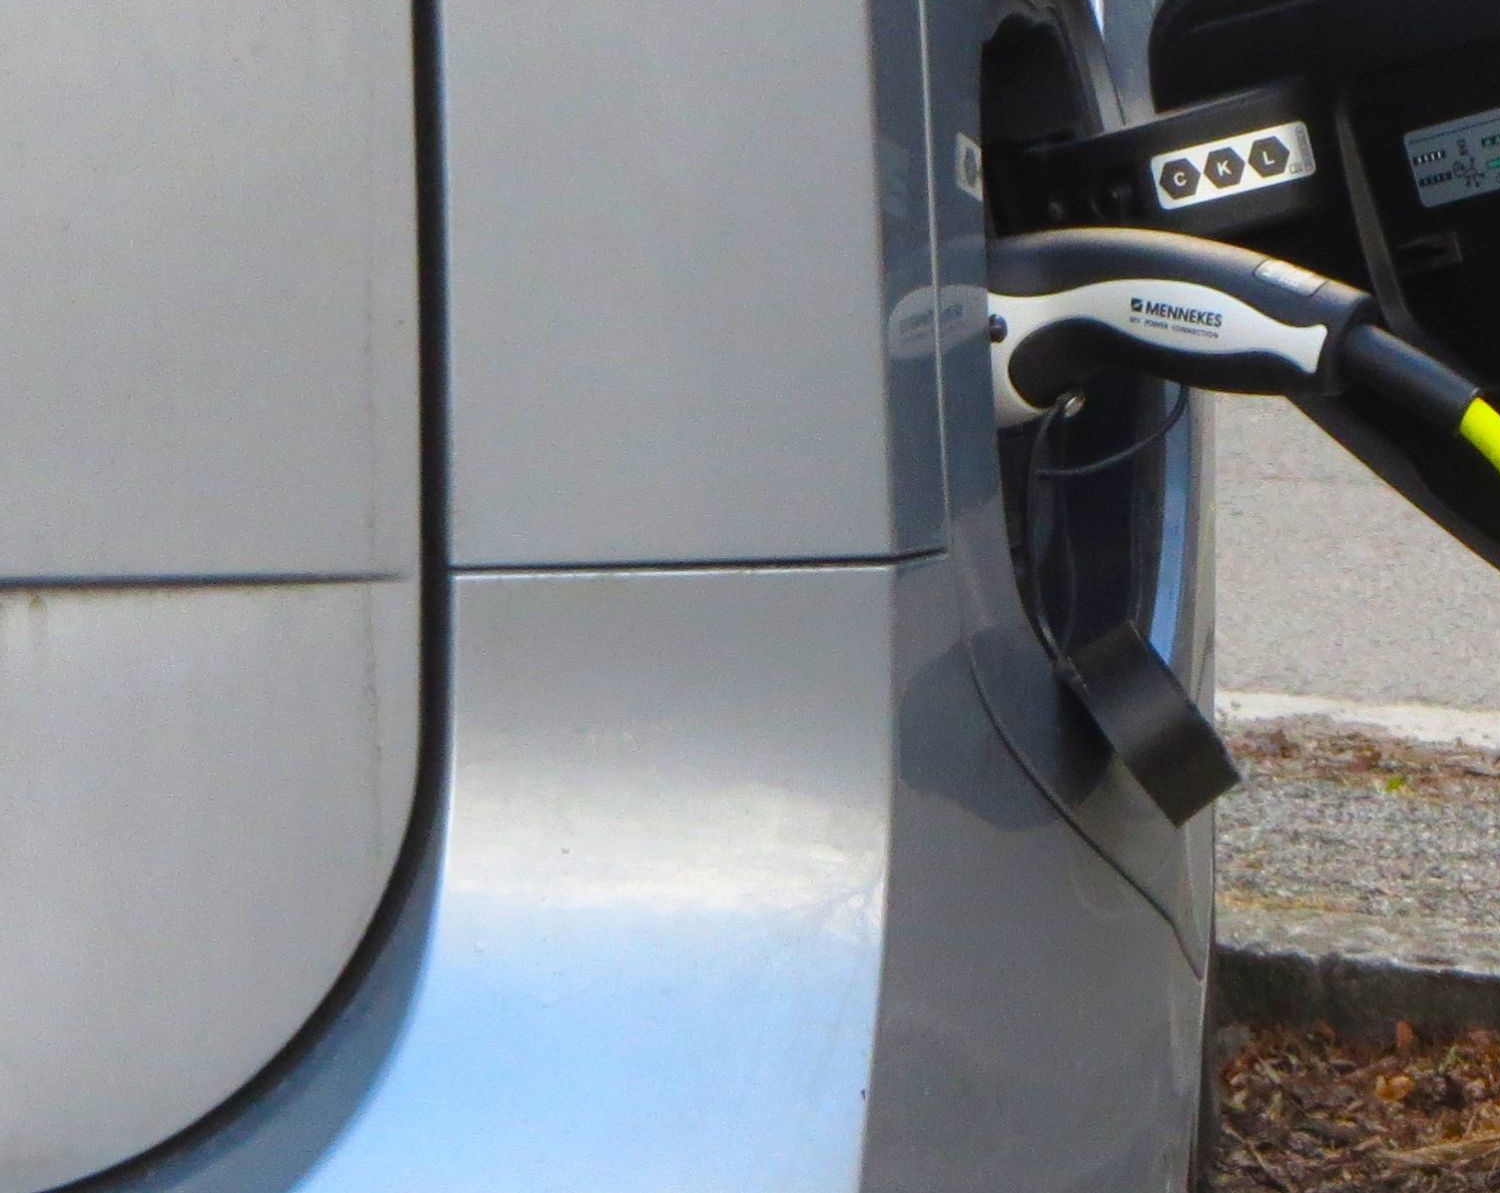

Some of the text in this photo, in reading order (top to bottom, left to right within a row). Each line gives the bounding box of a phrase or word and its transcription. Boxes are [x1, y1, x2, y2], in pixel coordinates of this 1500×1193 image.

[1173, 151, 1275, 187] C K L
[1146, 300, 1222, 327] MENNEKES
